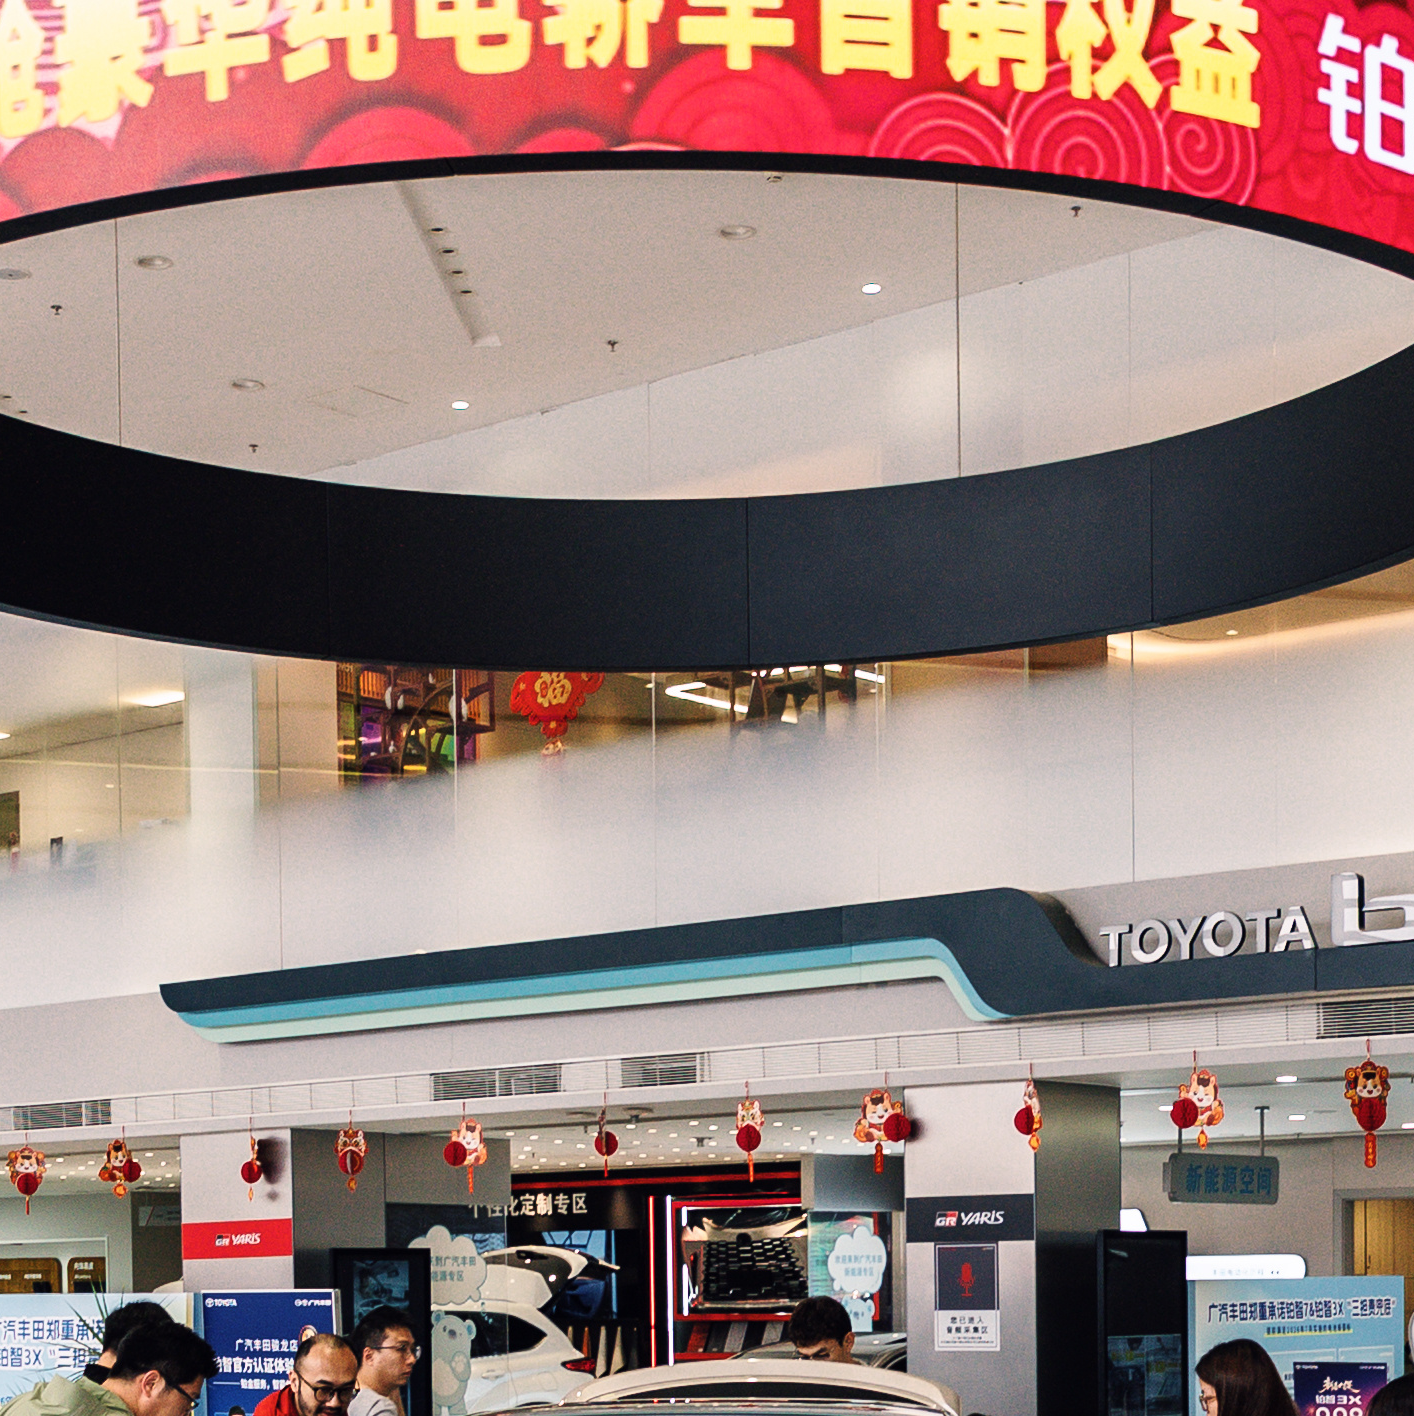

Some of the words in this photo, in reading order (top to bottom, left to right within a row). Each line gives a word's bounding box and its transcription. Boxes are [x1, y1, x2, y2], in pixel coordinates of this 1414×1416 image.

[1100, 905, 1317, 967] TOYOTA
[1185, 1162, 1273, 1196] 新能源空间
[935, 1213, 958, 1227] GR
[960, 1210, 1005, 1225] YARIS
[231, 1232, 262, 1245] YARIS
